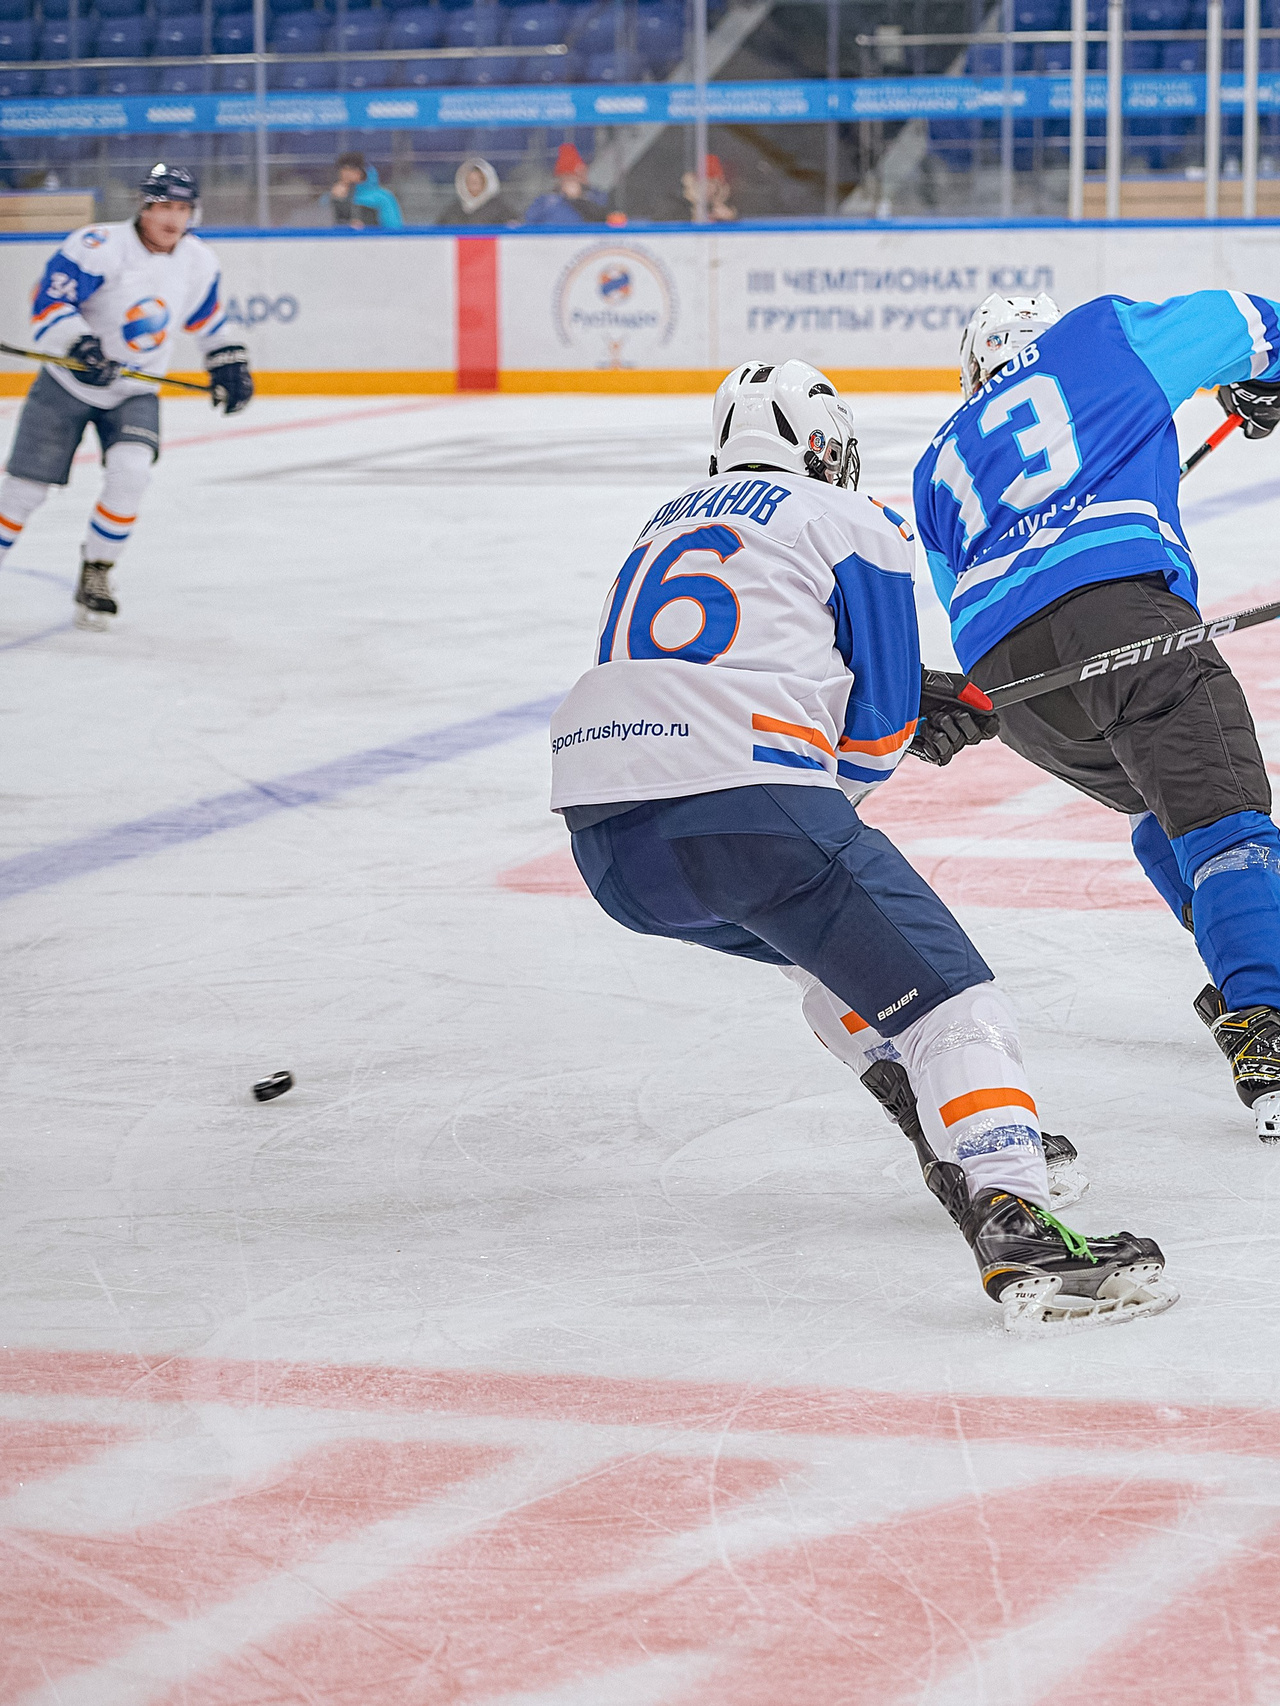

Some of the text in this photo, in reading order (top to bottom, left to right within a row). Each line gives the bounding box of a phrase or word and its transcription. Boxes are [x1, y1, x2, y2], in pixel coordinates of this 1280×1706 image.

[633, 480, 792, 549] РЮХАНОВ
[930, 371, 1083, 554] 13
[598, 523, 745, 666] 16
[876, 987, 919, 1021] BAUER
